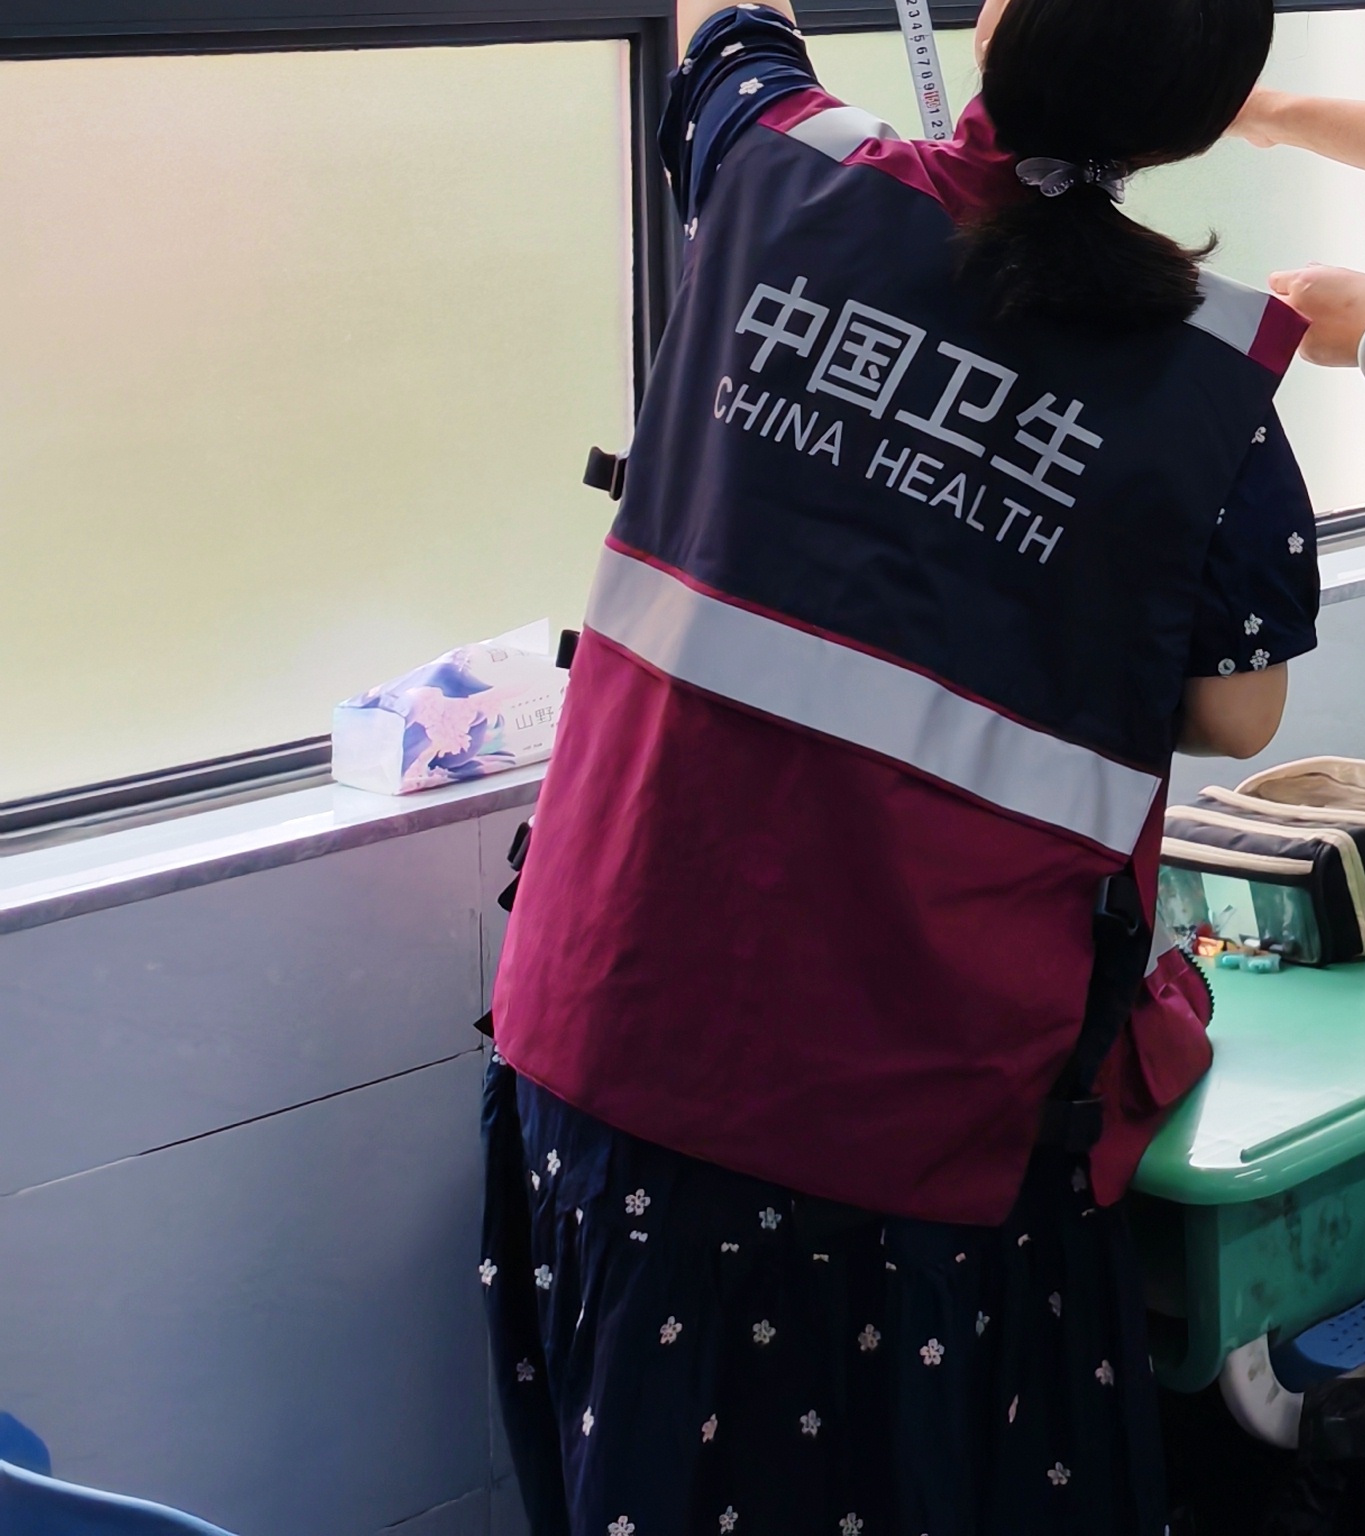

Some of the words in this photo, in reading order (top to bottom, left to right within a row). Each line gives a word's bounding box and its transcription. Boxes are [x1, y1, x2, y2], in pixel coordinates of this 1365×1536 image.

[713, 375, 845, 466] CHINA
[865, 438, 1065, 564] HEALTH
[734, 275, 1103, 508] 中国卫生
[515, 706, 563, 731] 山野
